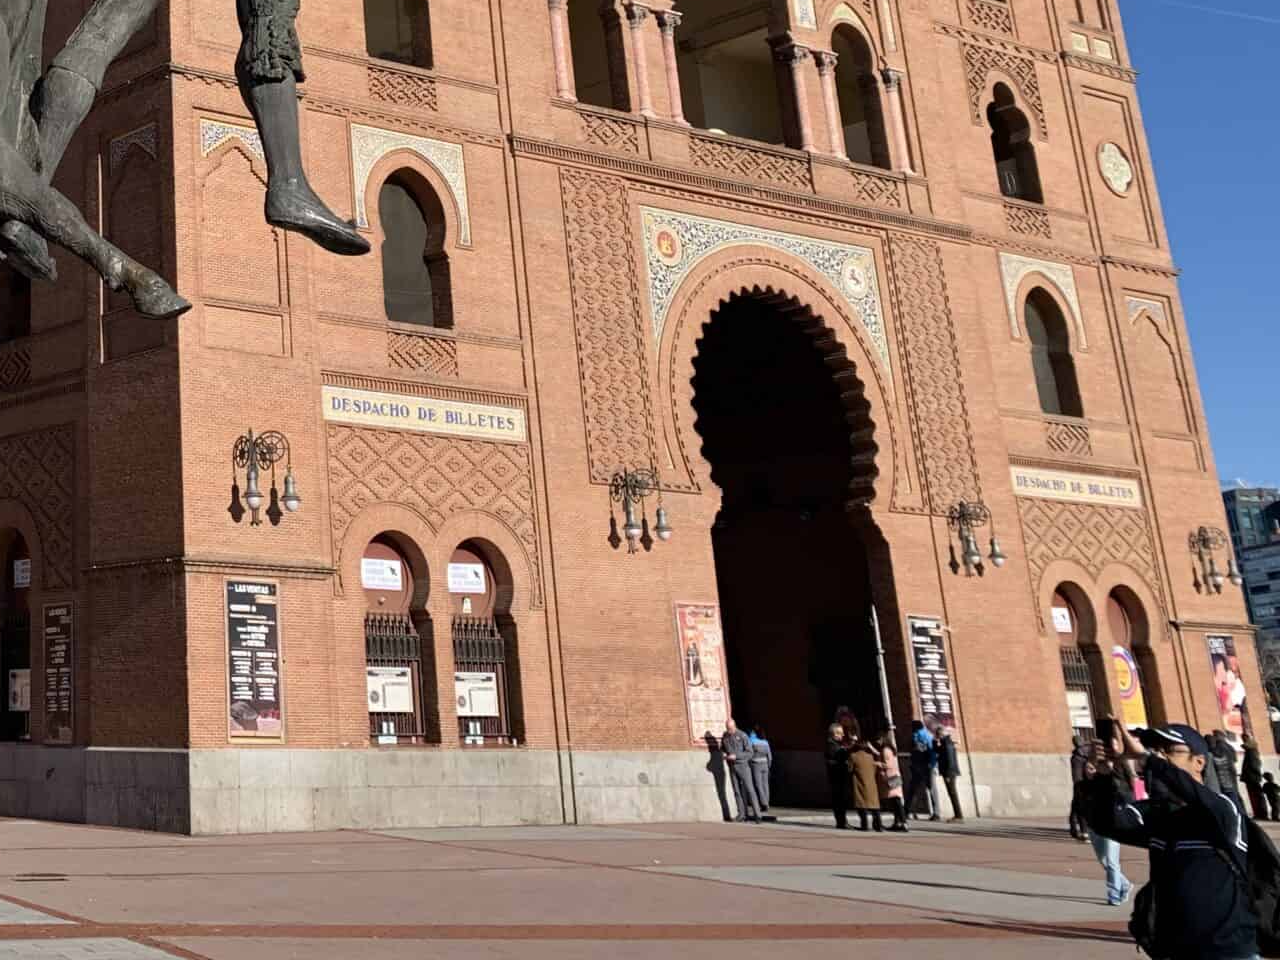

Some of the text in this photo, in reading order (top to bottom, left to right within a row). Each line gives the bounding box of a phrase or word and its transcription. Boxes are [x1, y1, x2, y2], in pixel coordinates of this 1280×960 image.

[332, 396, 515, 431] DESPACHO DE BILLETES
